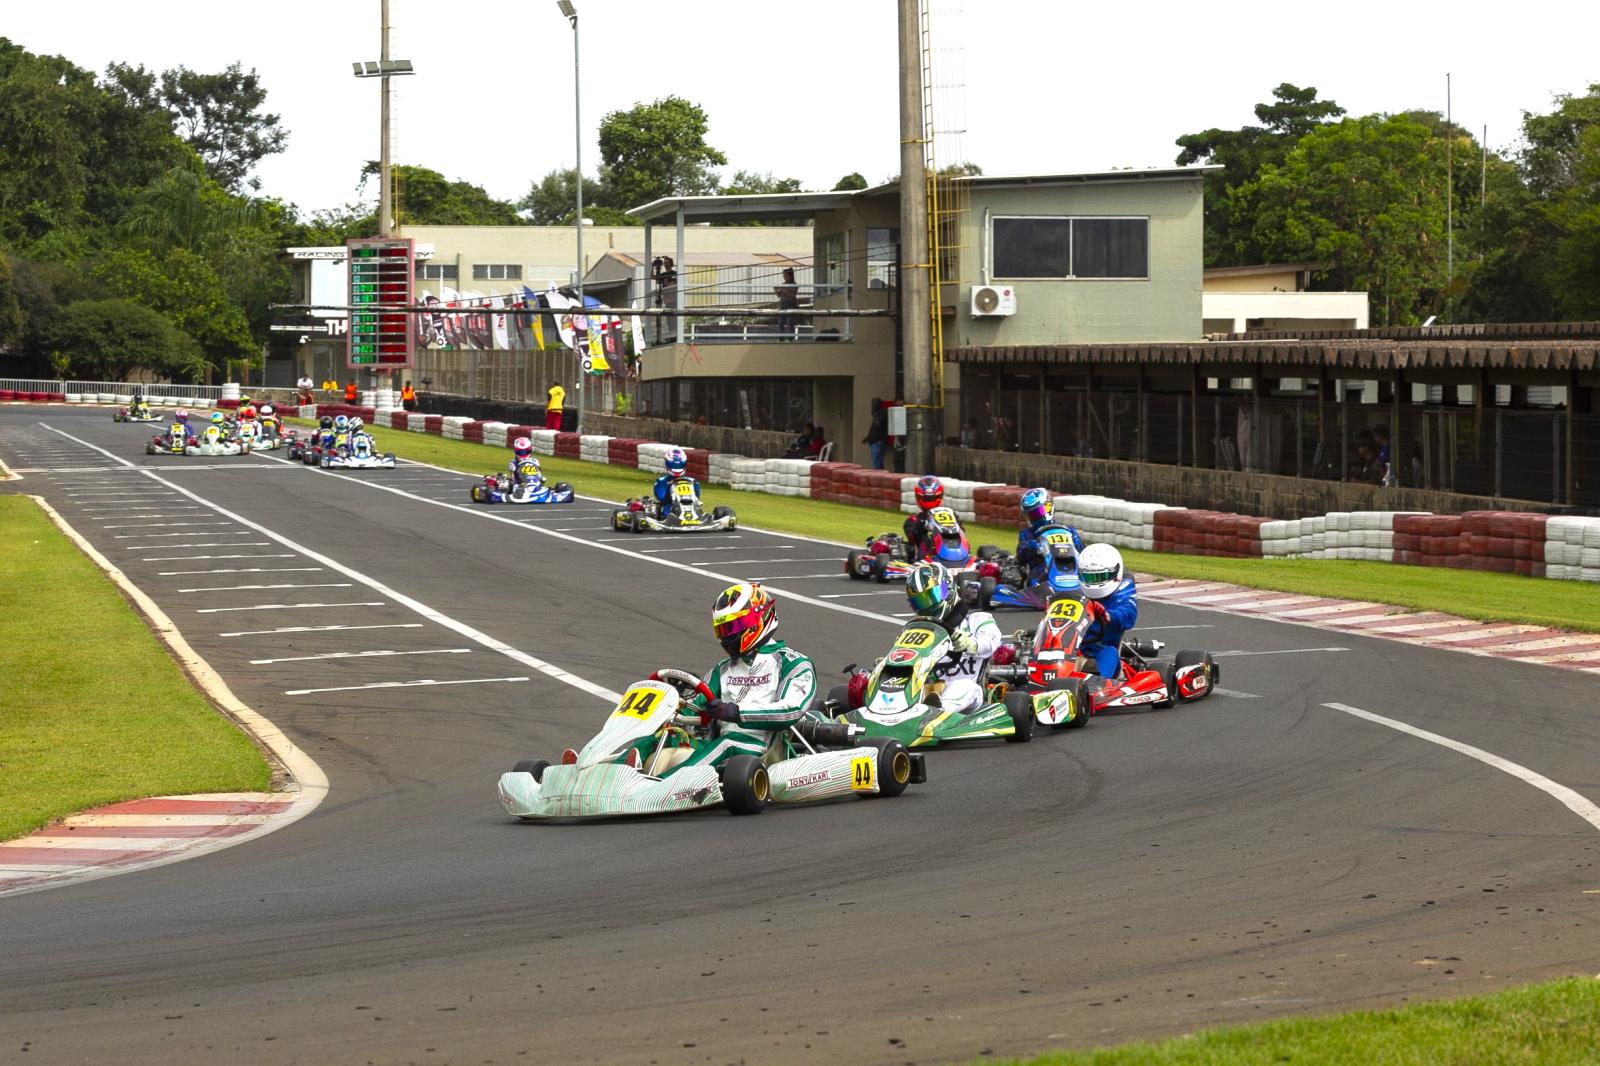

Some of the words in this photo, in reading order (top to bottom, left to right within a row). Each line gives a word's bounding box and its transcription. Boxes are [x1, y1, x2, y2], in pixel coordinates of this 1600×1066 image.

[938, 513, 954, 522] 51
[1050, 602, 1077, 617] 43
[899, 631, 930, 646] 188
[618, 692, 657, 716] 44
[855, 762, 871, 786] 44
